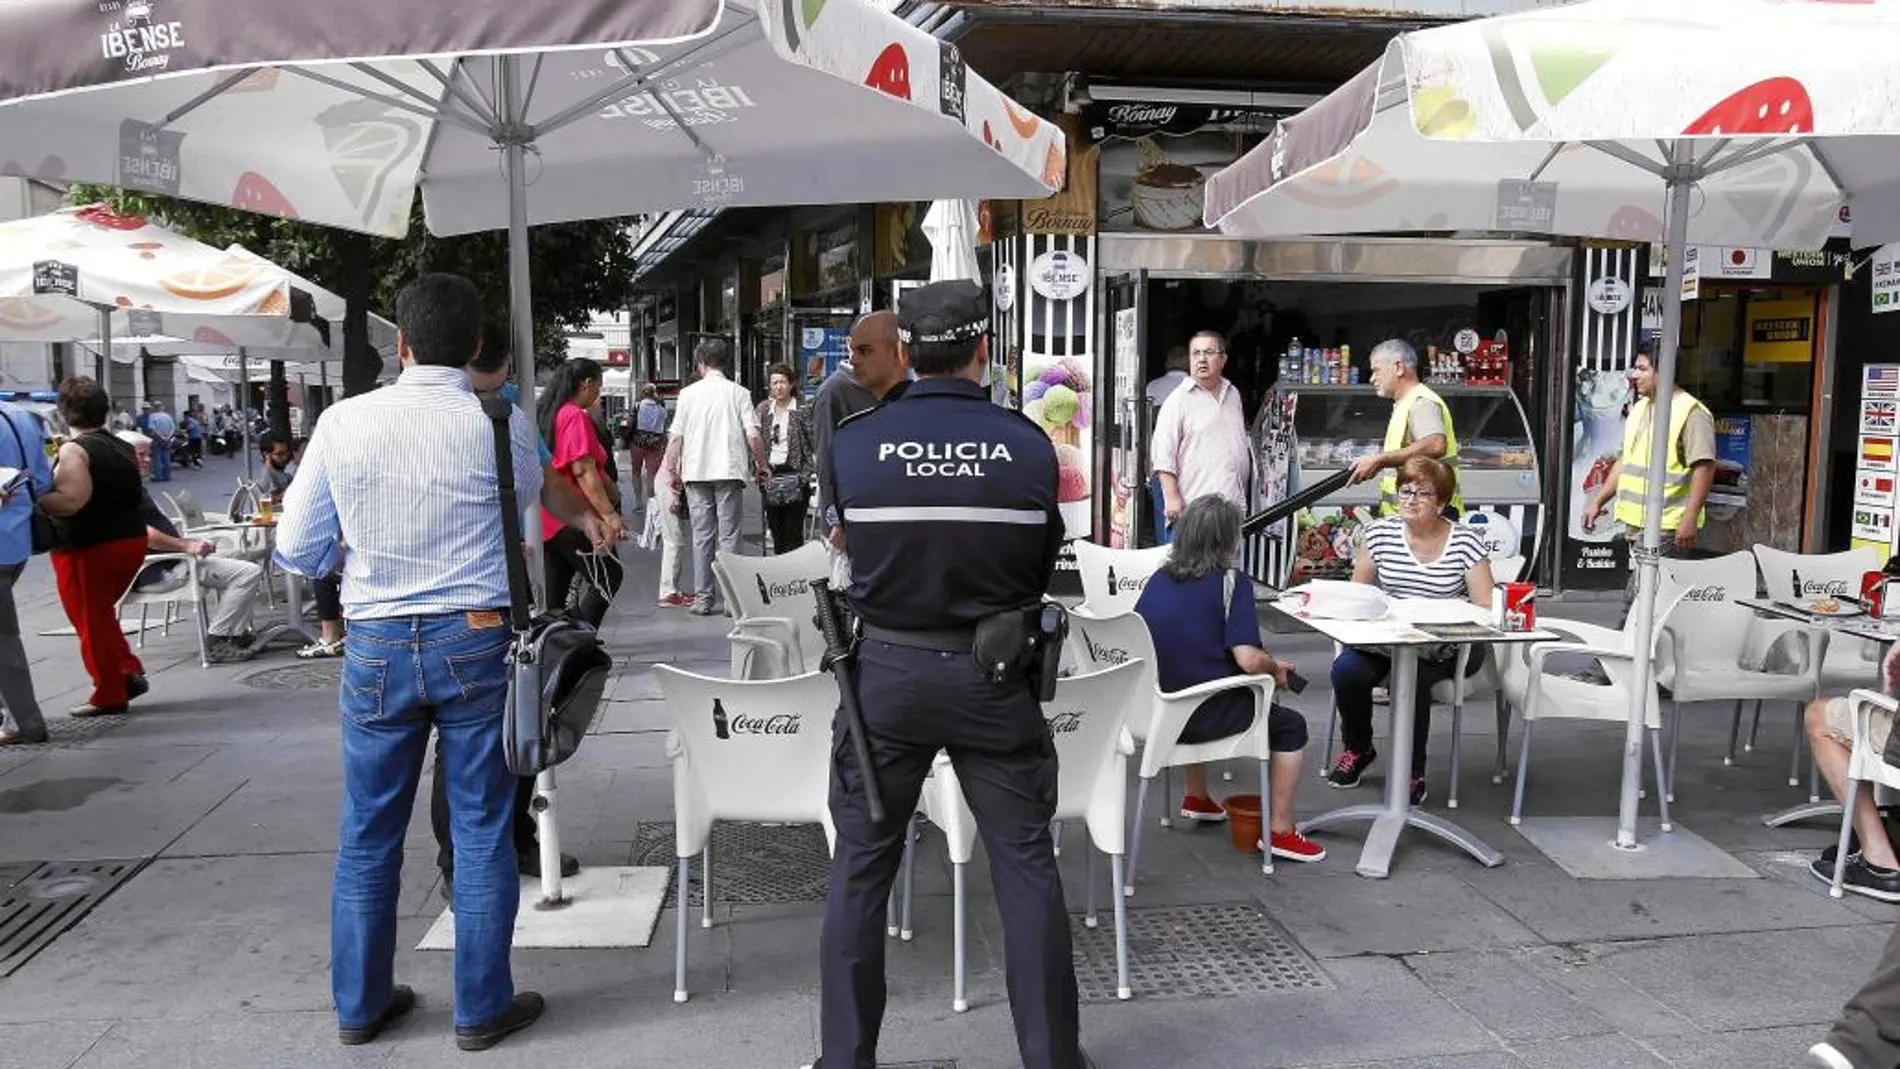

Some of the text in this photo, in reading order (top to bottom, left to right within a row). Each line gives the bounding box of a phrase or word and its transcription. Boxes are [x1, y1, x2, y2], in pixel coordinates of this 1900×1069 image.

[101, 21, 185, 58] IBENSE
[879, 441, 1013, 462] POLICIA
[906, 462, 985, 477] LOCAL
